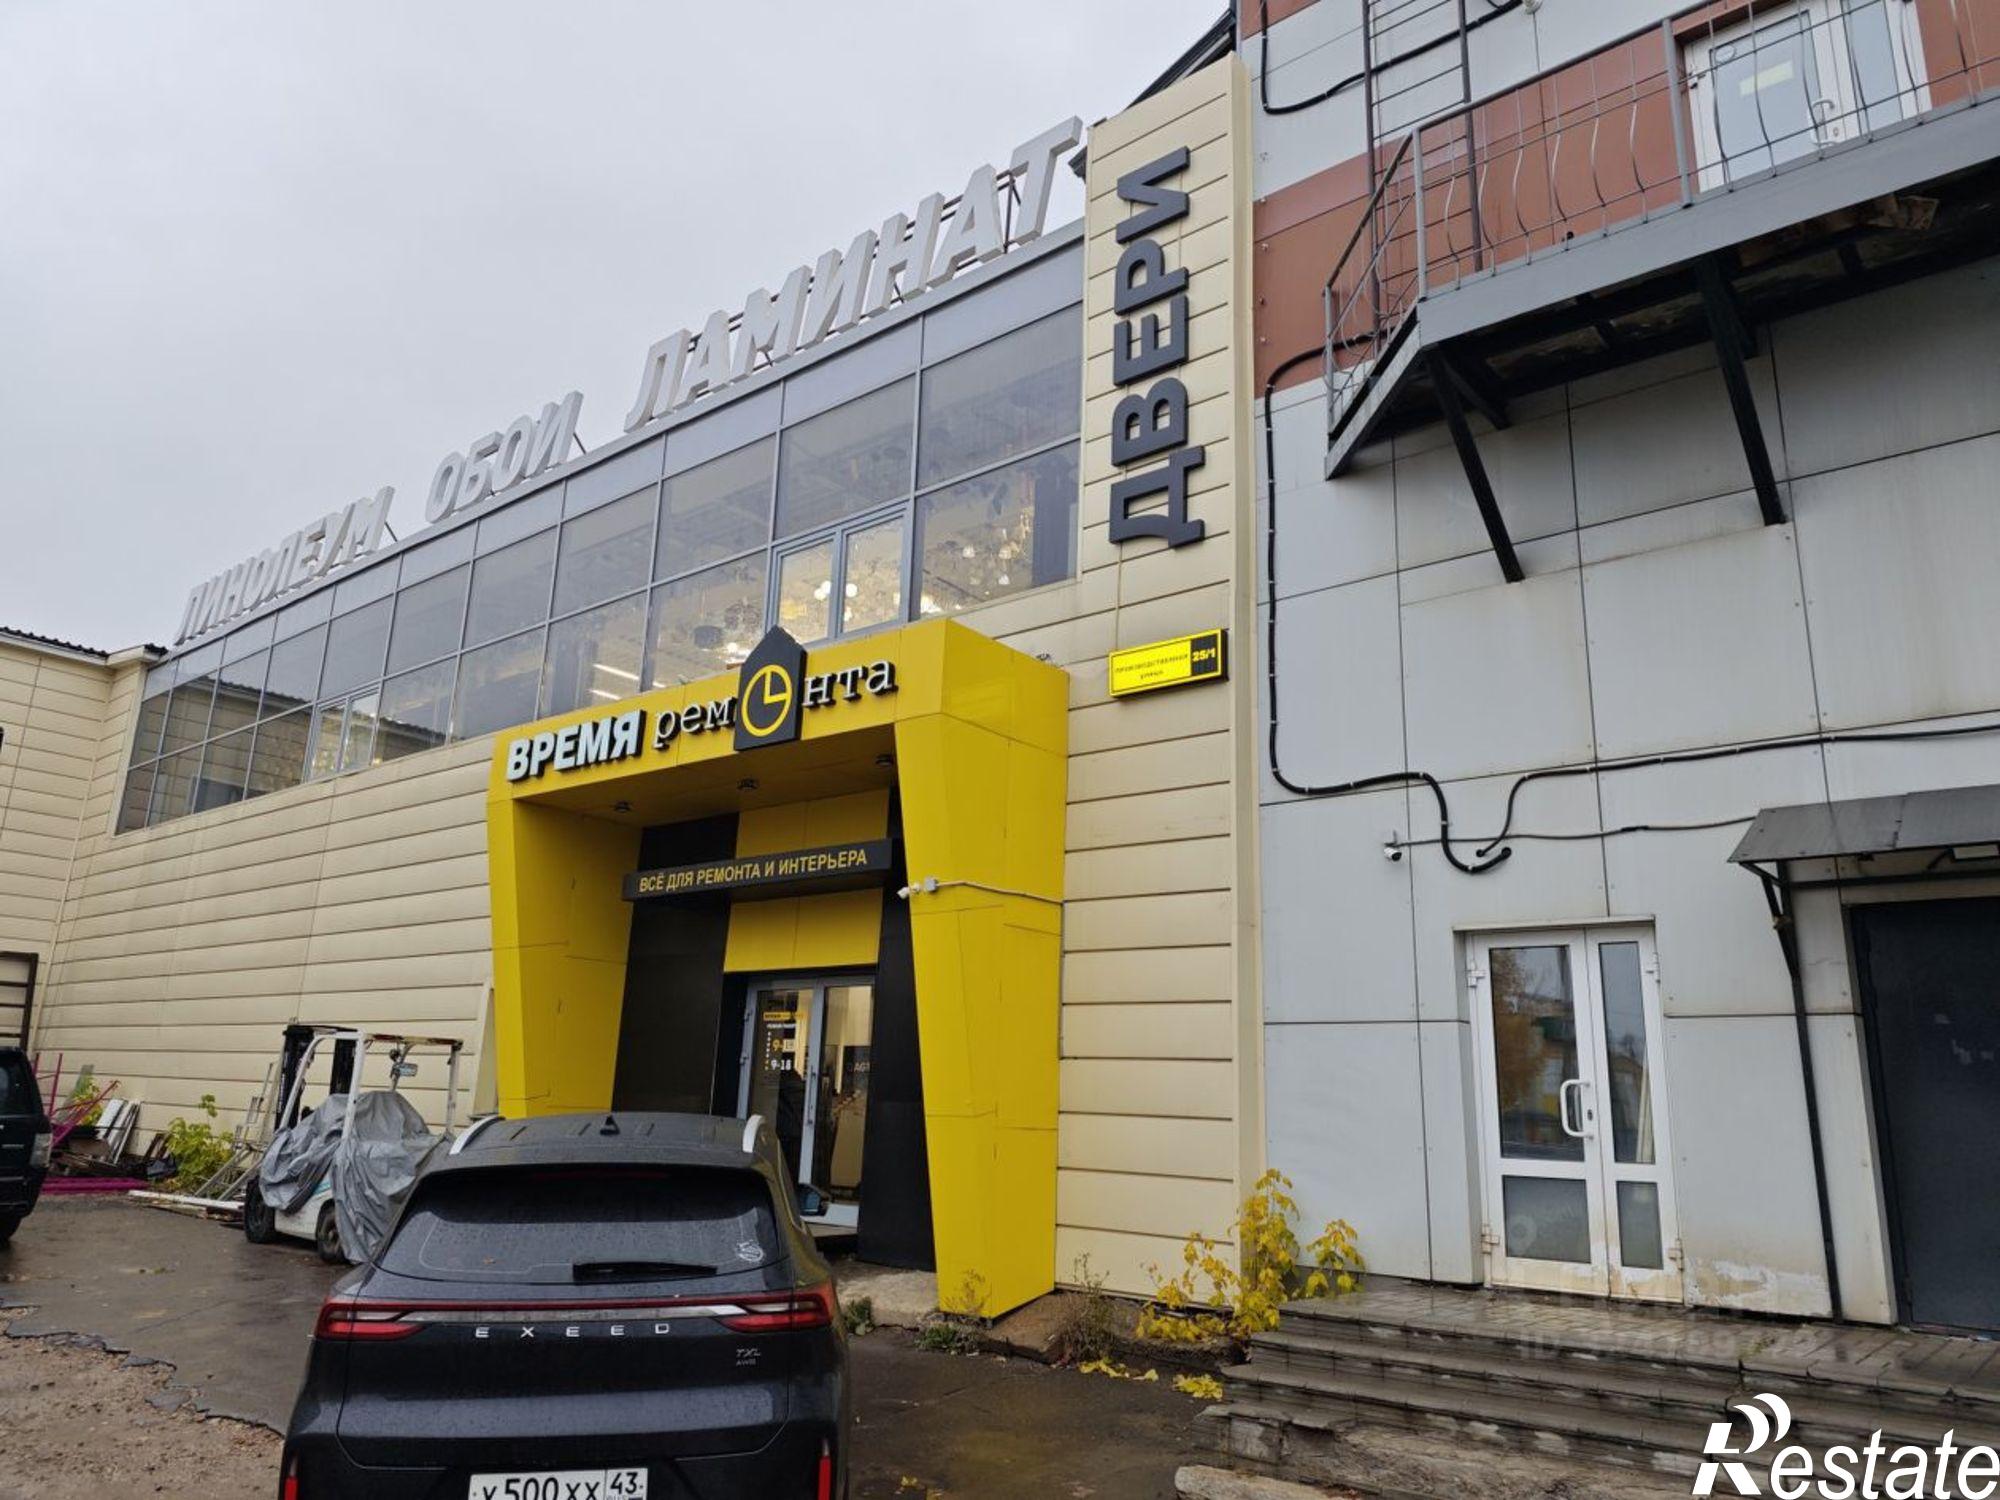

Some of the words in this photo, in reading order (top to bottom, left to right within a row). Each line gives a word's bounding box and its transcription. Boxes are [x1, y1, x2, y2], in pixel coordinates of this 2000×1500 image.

[1108, 145, 1205, 548] ДВЕРИ
[173, 485, 396, 647] ЛИНОЛЕУМ
[424, 390, 584, 523] ОБОИ
[623, 115, 1084, 433] ЛАМИНАТ
[1192, 648, 1216, 662] 25/1
[507, 709, 645, 782] ВРЕМЯ
[639, 872, 664, 893] ВСЁ
[666, 873, 693, 891] ДЛЯ
[696, 863, 761, 885] РЕМОНТА
[764, 862, 775, 877] И
[778, 848, 868, 876] ИНТЕРЬЕРА
[475, 1323, 670, 1338] EXEED
[610, 1471, 638, 1494] 43
